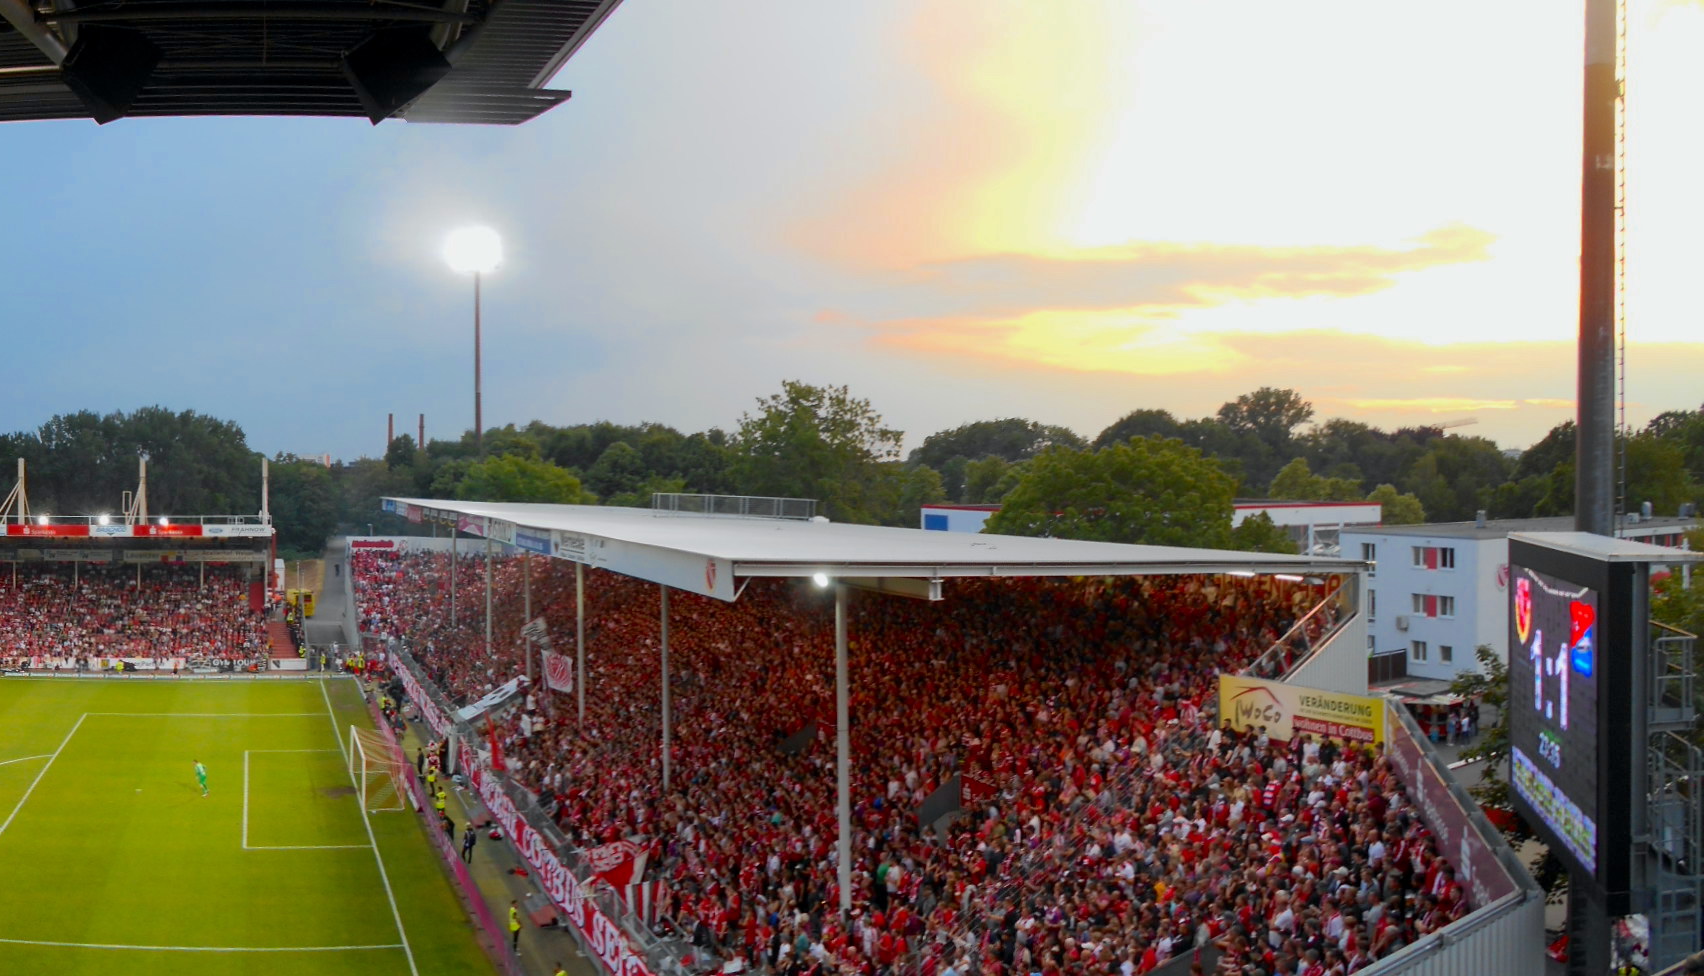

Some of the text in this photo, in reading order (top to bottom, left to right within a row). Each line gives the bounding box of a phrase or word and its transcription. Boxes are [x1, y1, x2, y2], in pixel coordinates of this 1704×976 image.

[1531, 629, 1567, 731] 1:1
[1299, 693, 1372, 717] VERÄNDERUNG
[1328, 721, 1337, 735] in
[1338, 723, 1373, 740] Cottbus
